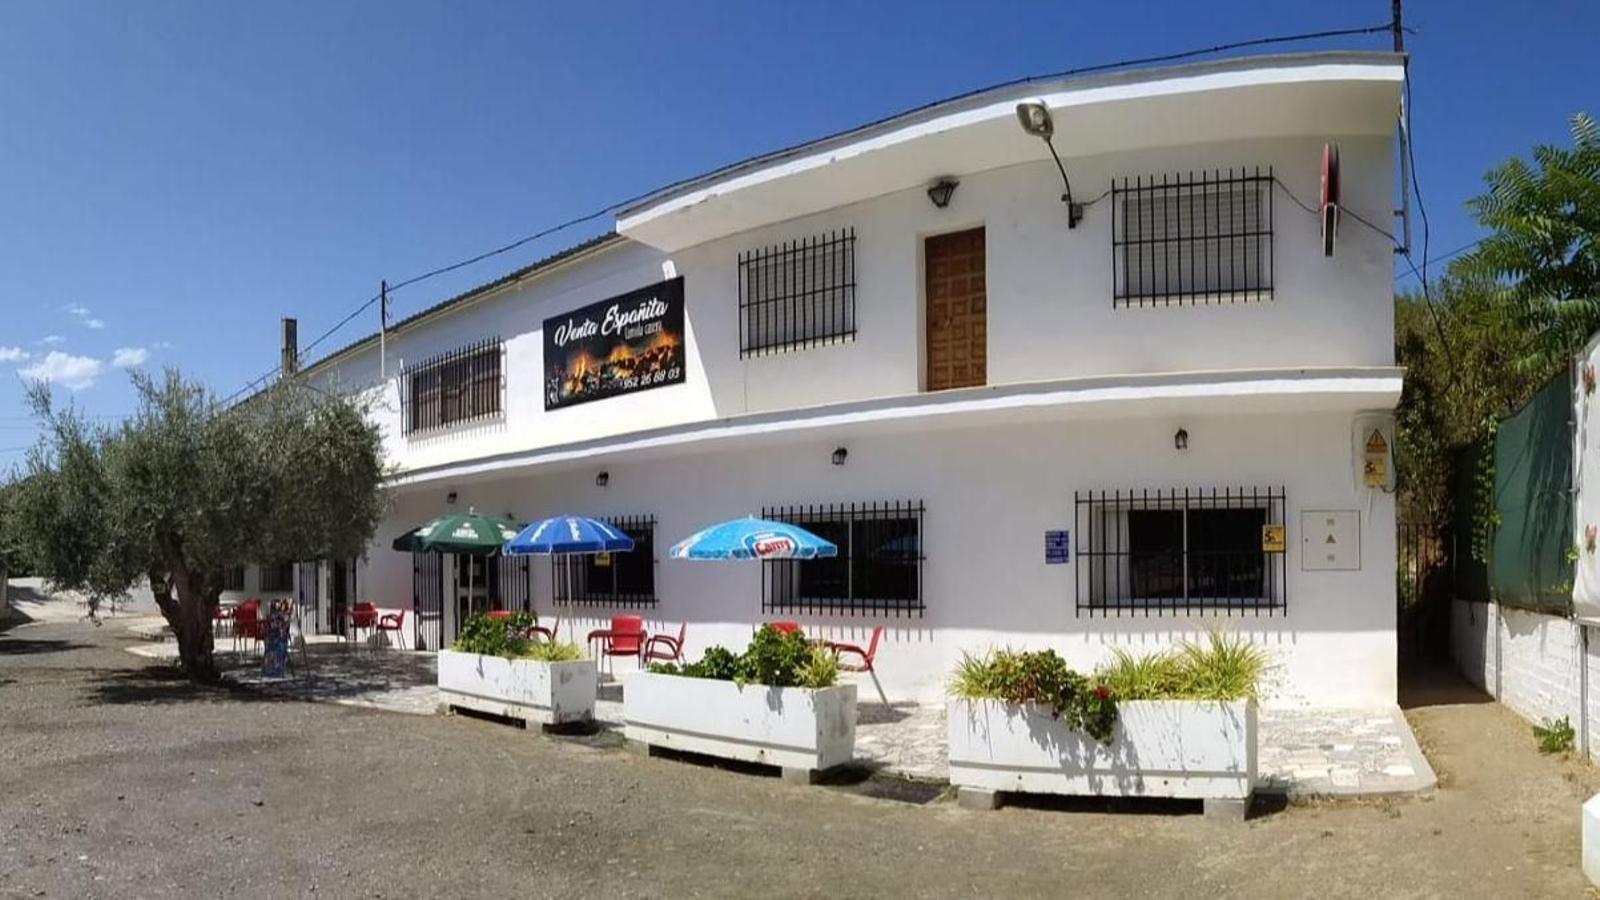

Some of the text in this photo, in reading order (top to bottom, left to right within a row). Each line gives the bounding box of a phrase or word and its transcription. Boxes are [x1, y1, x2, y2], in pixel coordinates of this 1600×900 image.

[554, 298, 669, 347] Venta Españita
[623, 376, 639, 390] 952
